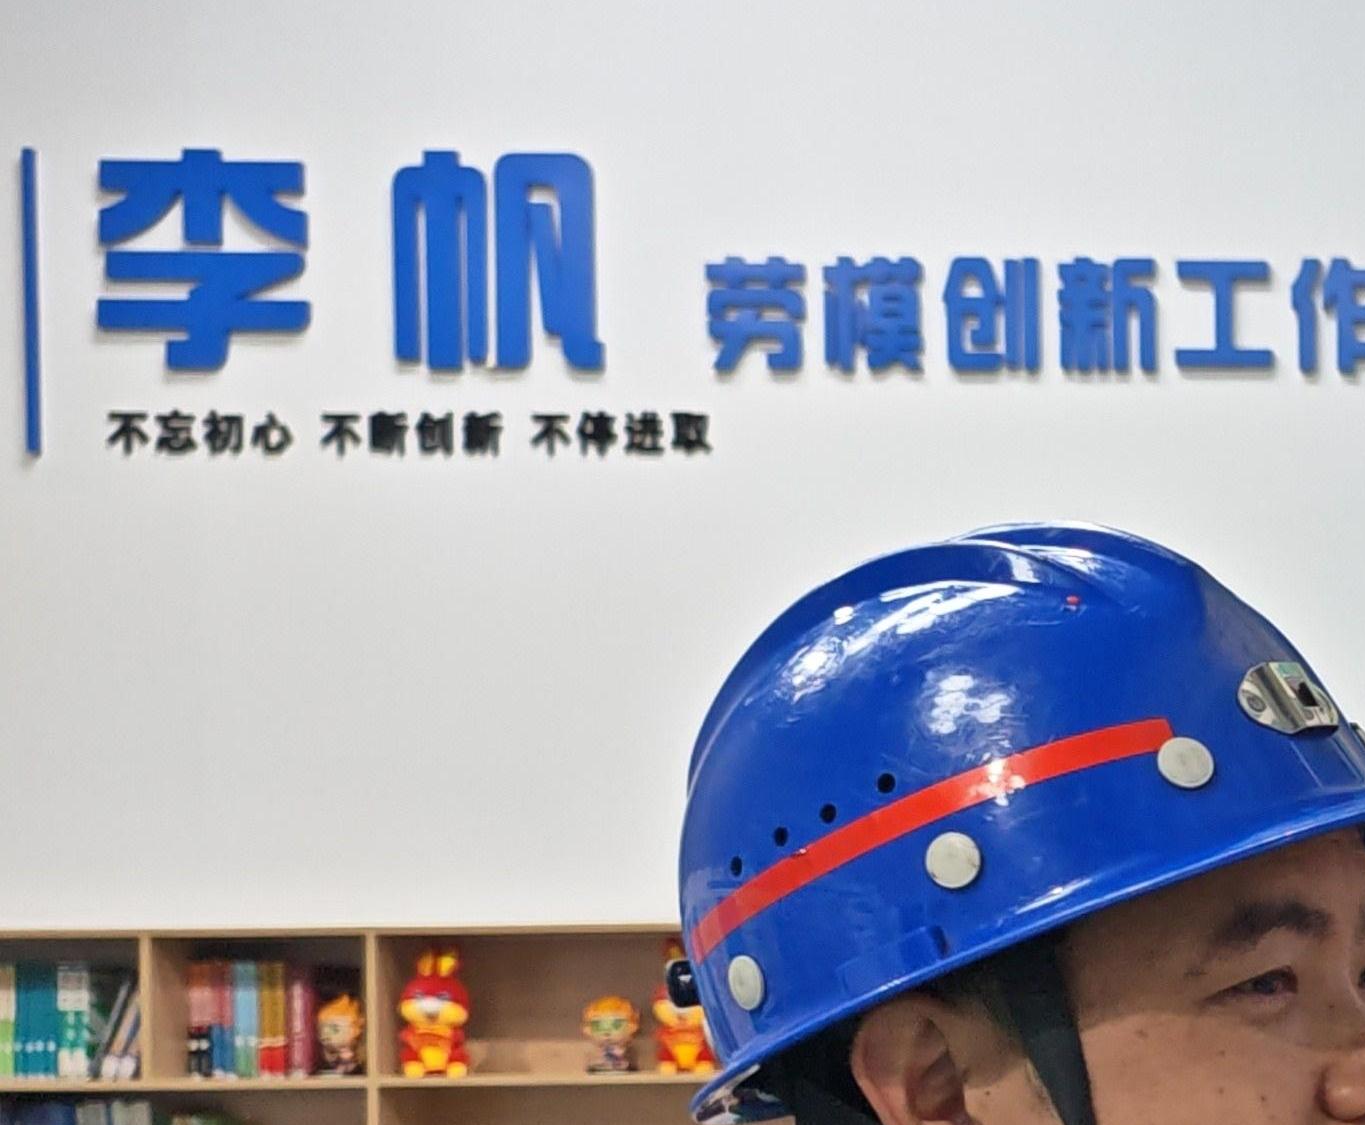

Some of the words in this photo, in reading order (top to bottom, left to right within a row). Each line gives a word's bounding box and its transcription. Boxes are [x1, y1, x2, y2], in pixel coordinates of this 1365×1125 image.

[96, 148, 606, 372] 李帆
[106, 410, 294, 457] 不忘初心
[319, 410, 504, 457] 不断创新
[529, 410, 713, 457] 不停进取
